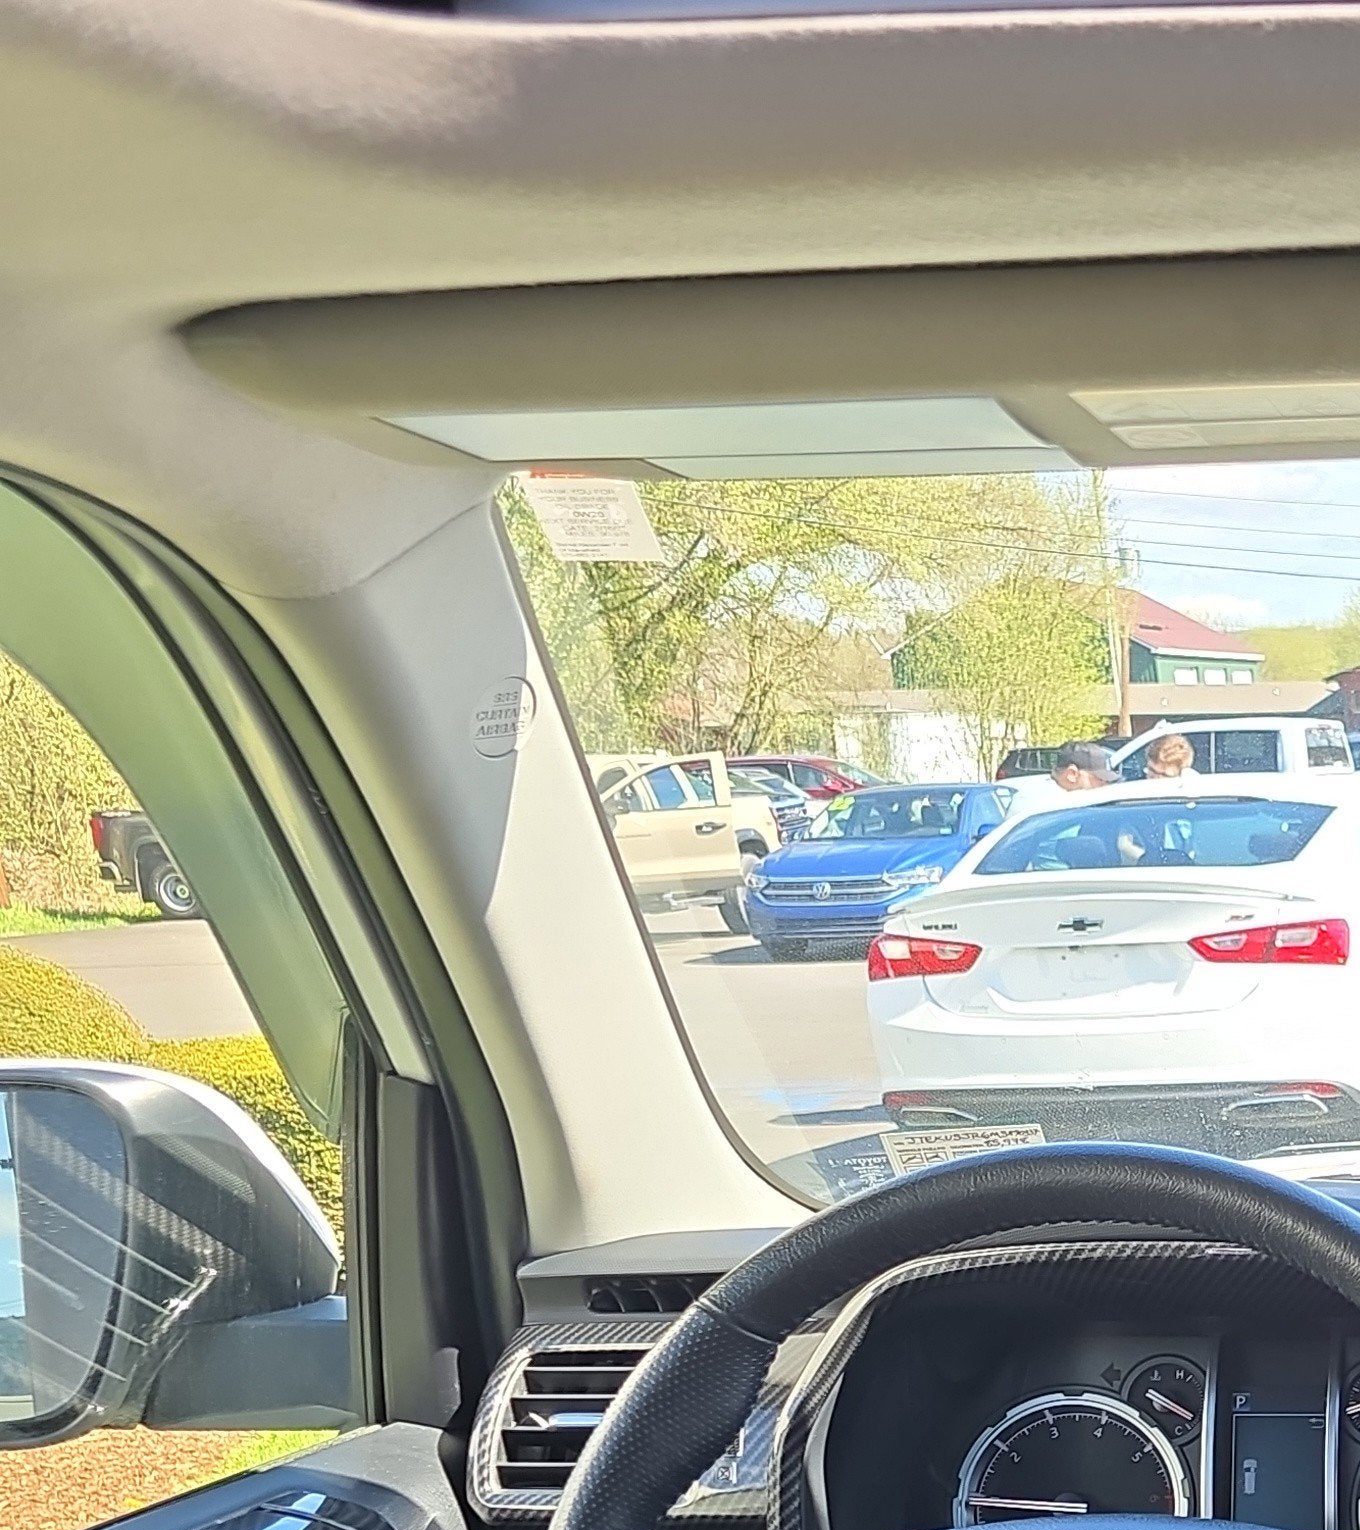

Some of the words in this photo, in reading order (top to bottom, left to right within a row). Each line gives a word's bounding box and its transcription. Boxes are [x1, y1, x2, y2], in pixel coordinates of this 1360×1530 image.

[1175, 1369, 1184, 1380] H
[1236, 1395, 1247, 1409] P
[1049, 1427, 1060, 1440] 3
[1093, 1427, 1103, 1439] 4
[1174, 1425, 1183, 1436] C
[1010, 1451, 1022, 1463] 2
[1131, 1452, 1142, 1463] 5
